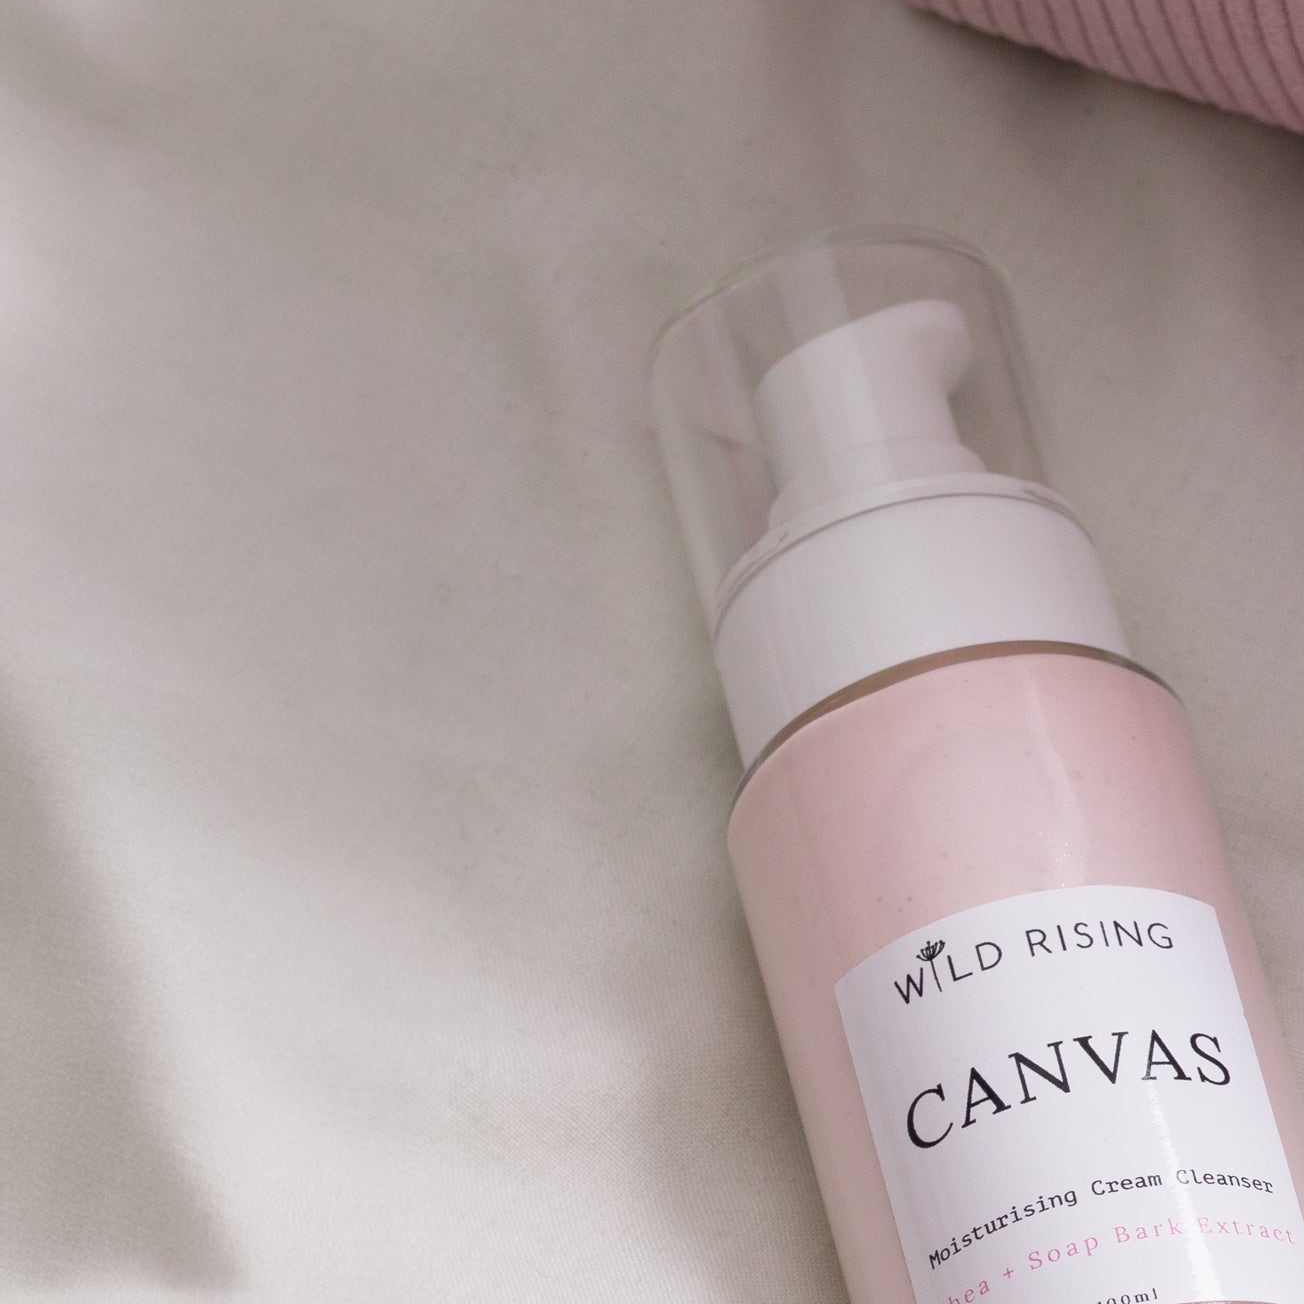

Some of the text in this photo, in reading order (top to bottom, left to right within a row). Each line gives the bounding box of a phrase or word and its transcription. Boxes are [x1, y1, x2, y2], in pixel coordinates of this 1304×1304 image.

[894, 920, 1173, 1004] WILD RISING
[906, 1030, 1231, 1149] CANVAS
[929, 1169, 1273, 1270] Moisturising Cream Cleanser
[1028, 1234, 1099, 1271] Soap
[1113, 1218, 1183, 1244] Bark
[1199, 1216, 1295, 1246] Extract
